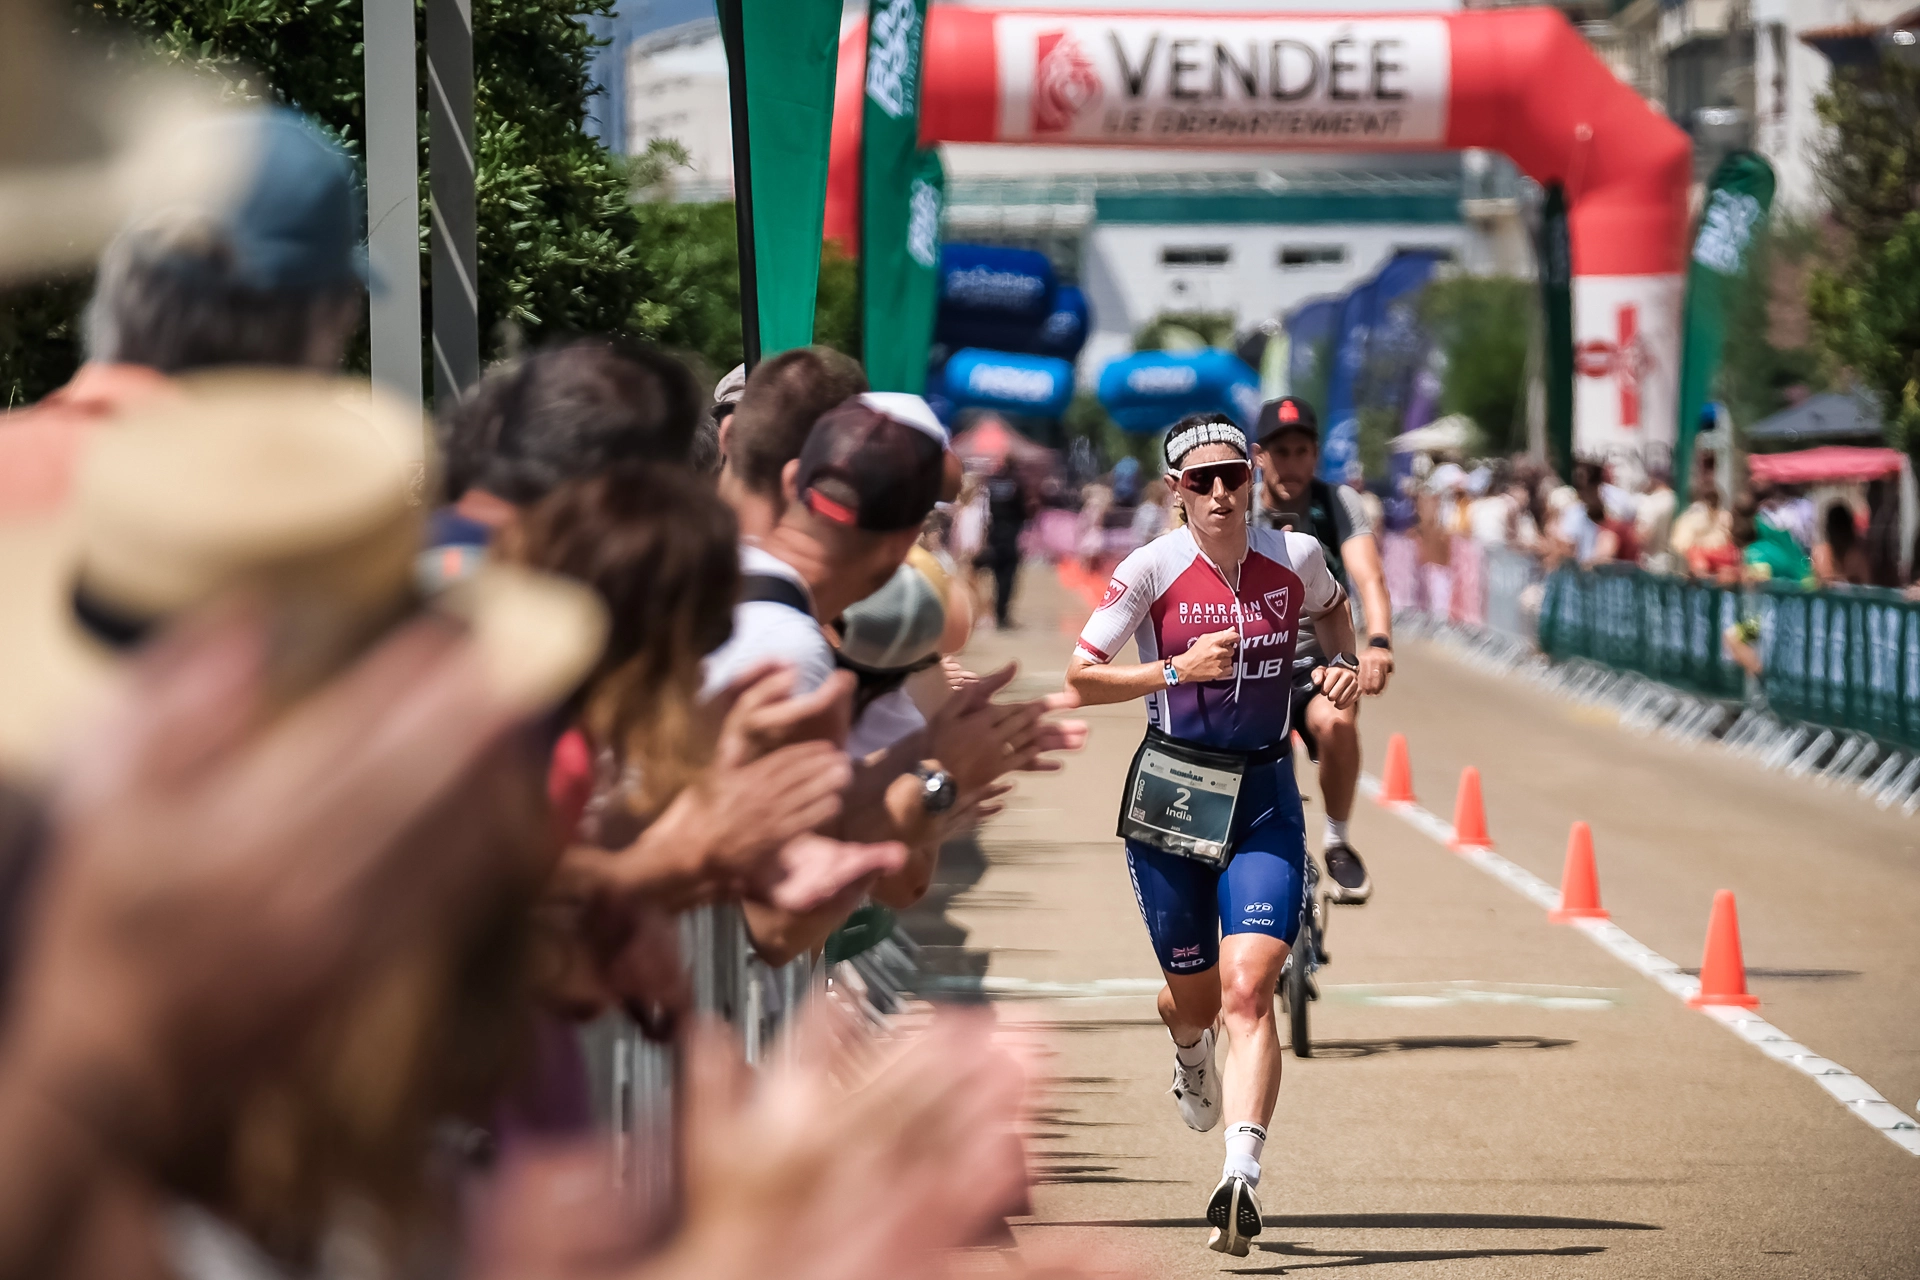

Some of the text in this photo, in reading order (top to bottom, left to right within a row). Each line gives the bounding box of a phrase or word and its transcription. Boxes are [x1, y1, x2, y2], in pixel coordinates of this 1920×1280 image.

[1107, 28, 1406, 100] VENDÉE
[1180, 601, 1260, 615] BAHRAIN
[1180, 612, 1262, 624] VICTORIOUS
[1136, 779, 1146, 801] FPRO
[1173, 787, 1191, 810] 2
[1165, 806, 1192, 821] India
